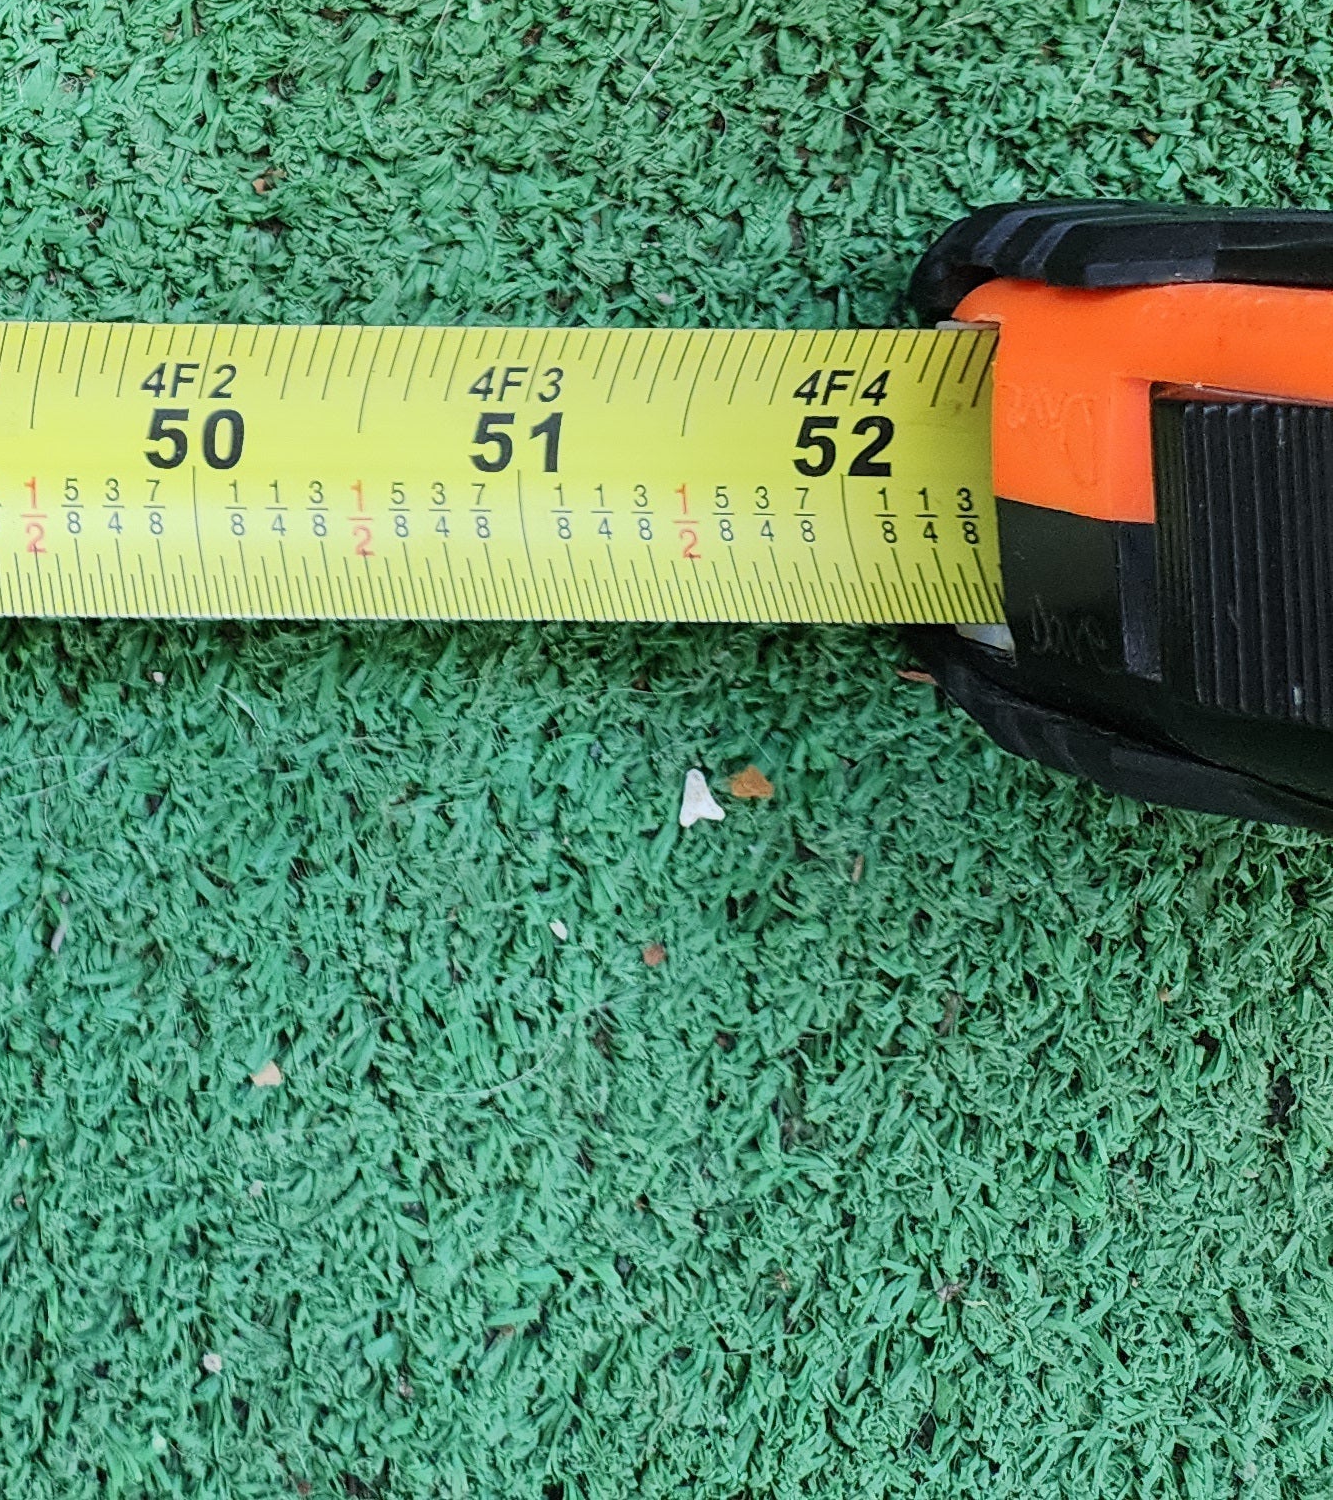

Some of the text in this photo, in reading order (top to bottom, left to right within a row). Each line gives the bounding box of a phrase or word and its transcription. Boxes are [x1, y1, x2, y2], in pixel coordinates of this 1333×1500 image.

[144, 408, 244, 470] 50
[469, 412, 563, 473] 51
[792, 415, 895, 478] 52
